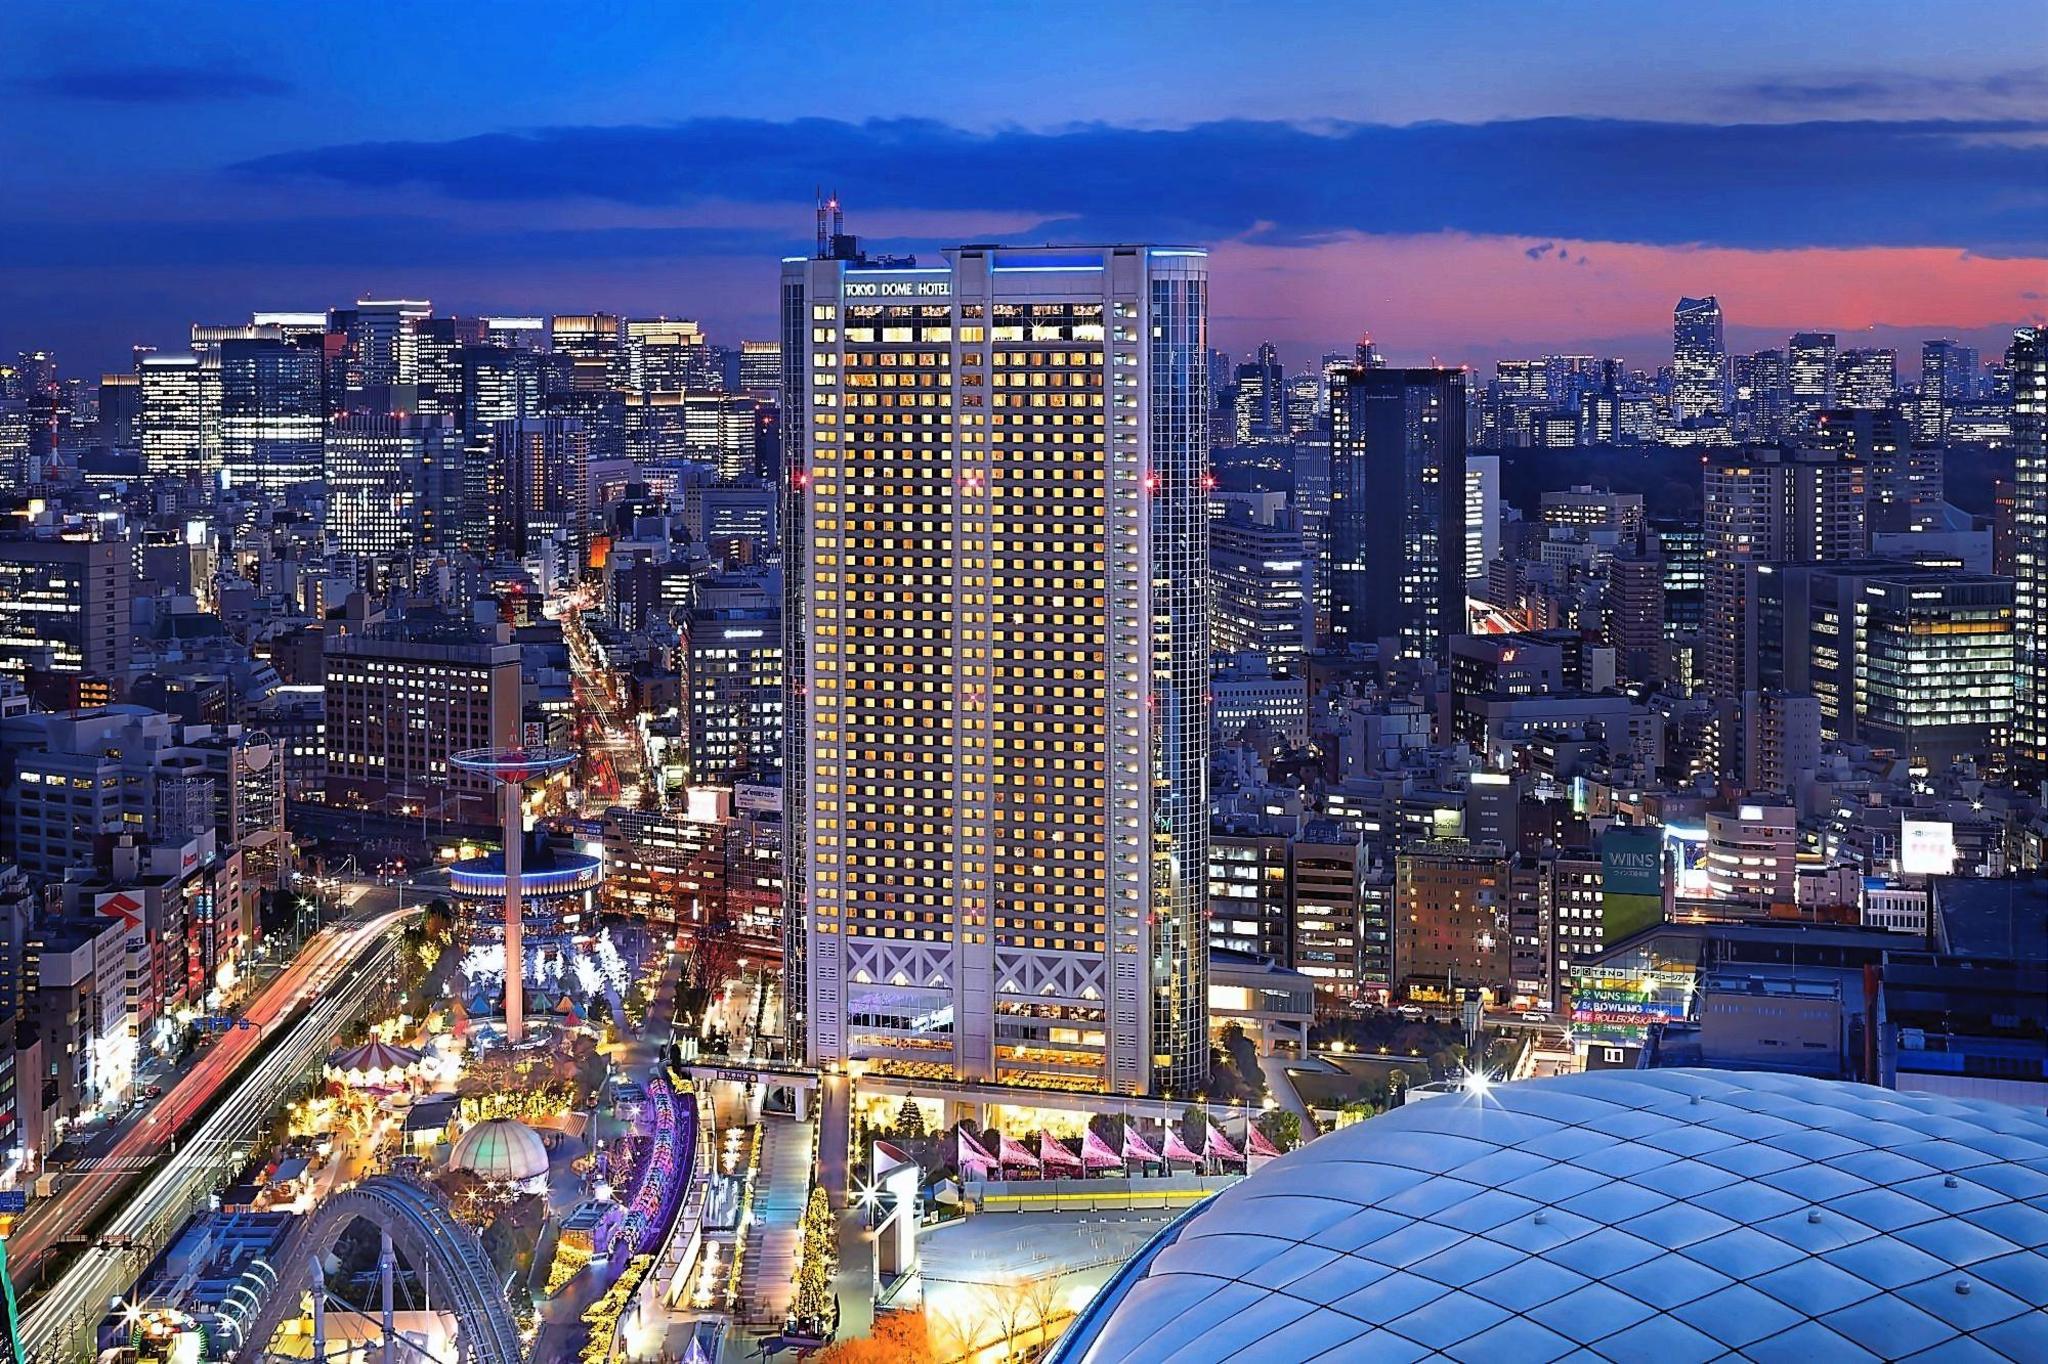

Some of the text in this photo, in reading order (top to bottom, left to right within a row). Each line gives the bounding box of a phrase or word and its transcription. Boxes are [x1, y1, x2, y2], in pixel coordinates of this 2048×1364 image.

[845, 283, 950, 296] TOKYO DOME HOTEL
[1609, 852, 1655, 868] WINS
[1593, 1002, 1643, 1013] BOWLING
